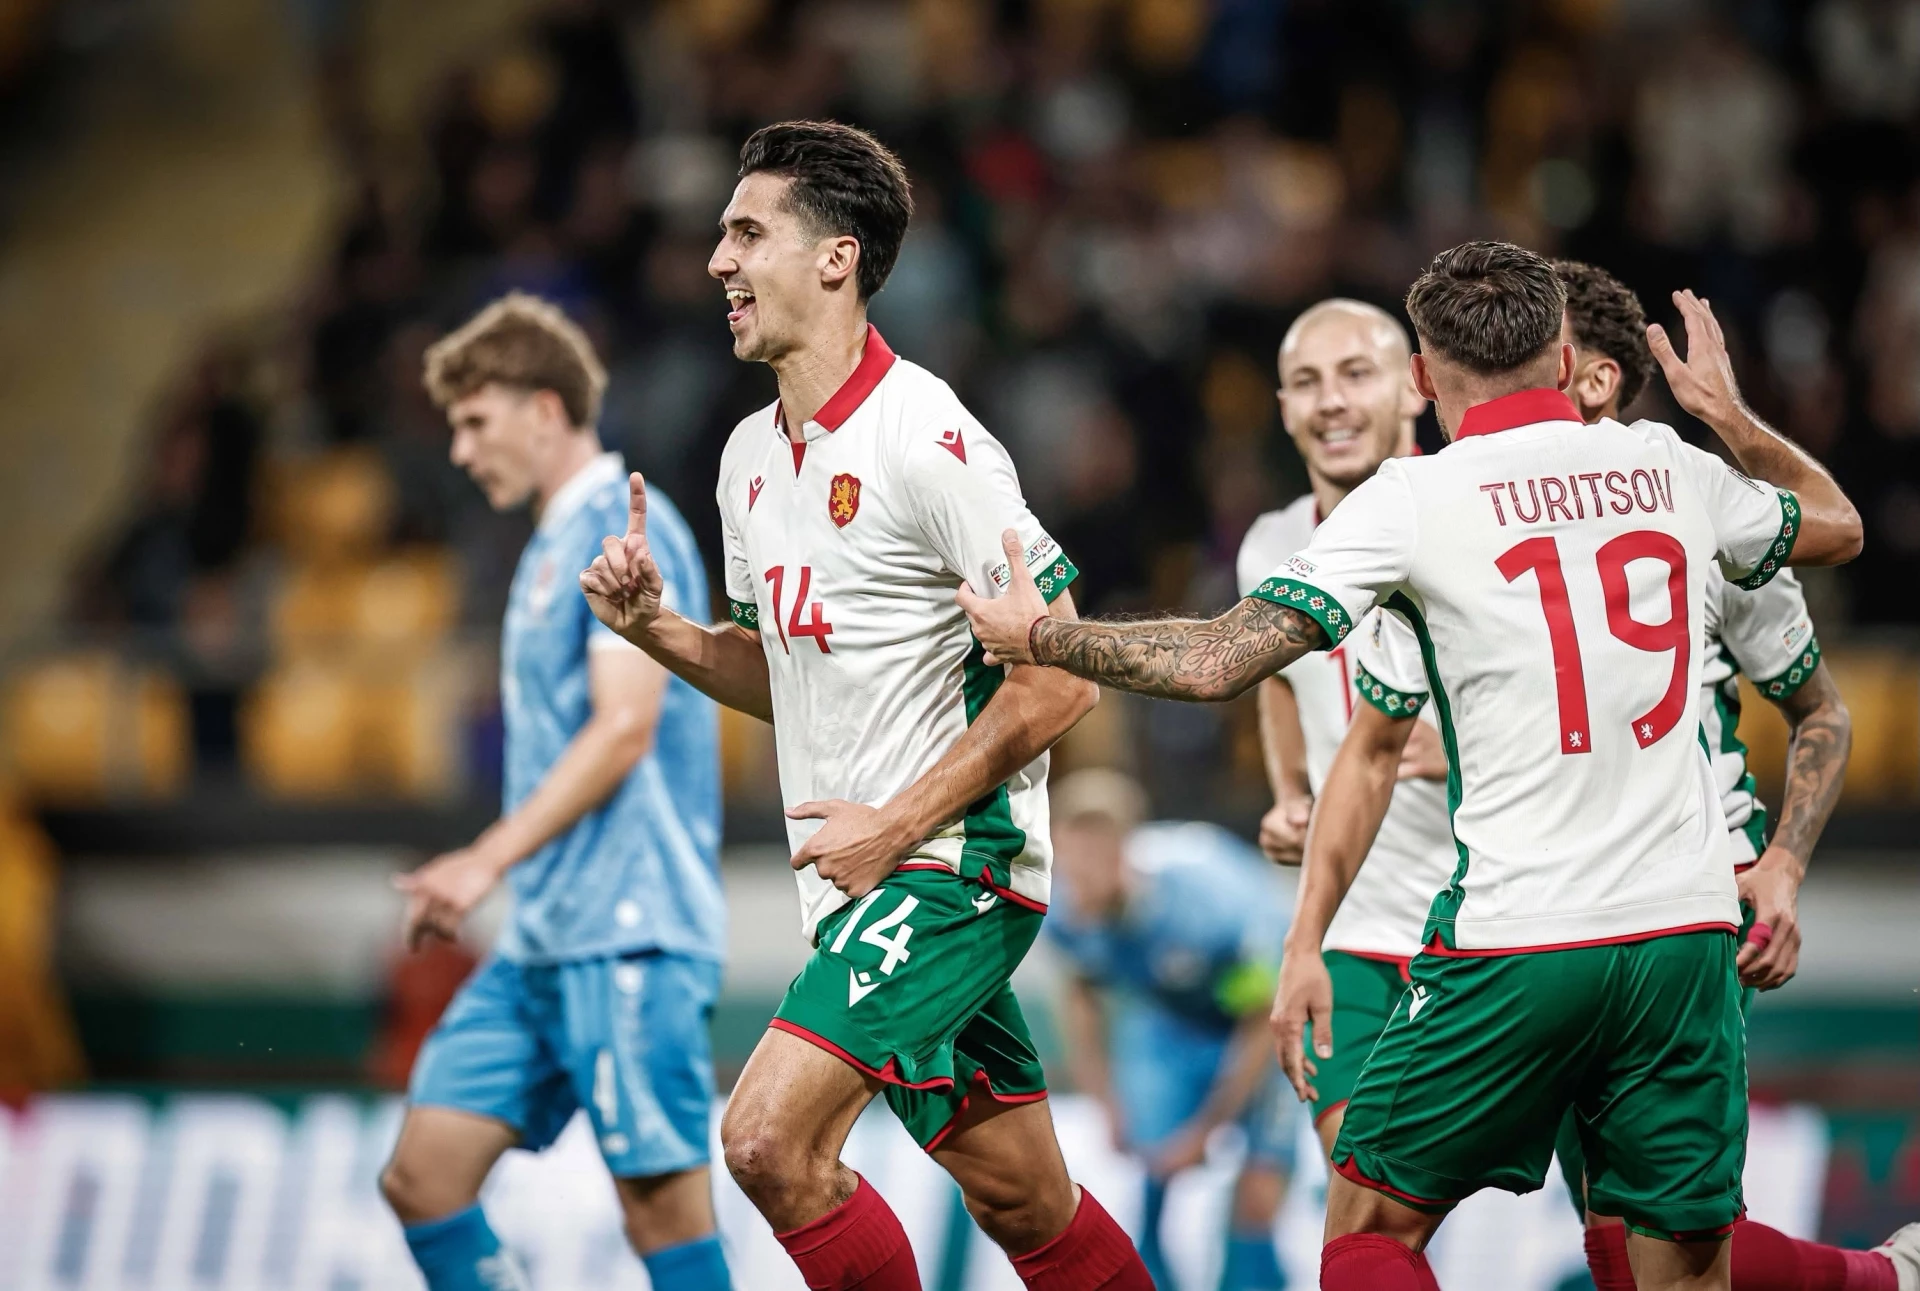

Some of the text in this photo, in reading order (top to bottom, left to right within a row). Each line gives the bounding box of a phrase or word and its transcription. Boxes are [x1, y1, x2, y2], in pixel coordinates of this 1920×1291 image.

[1479, 468, 1675, 526] TURITSOV
[764, 565, 834, 656] 14
[990, 562, 1008, 577] UEFA
[1494, 530, 1691, 755] 19
[829, 888, 920, 977] 14
